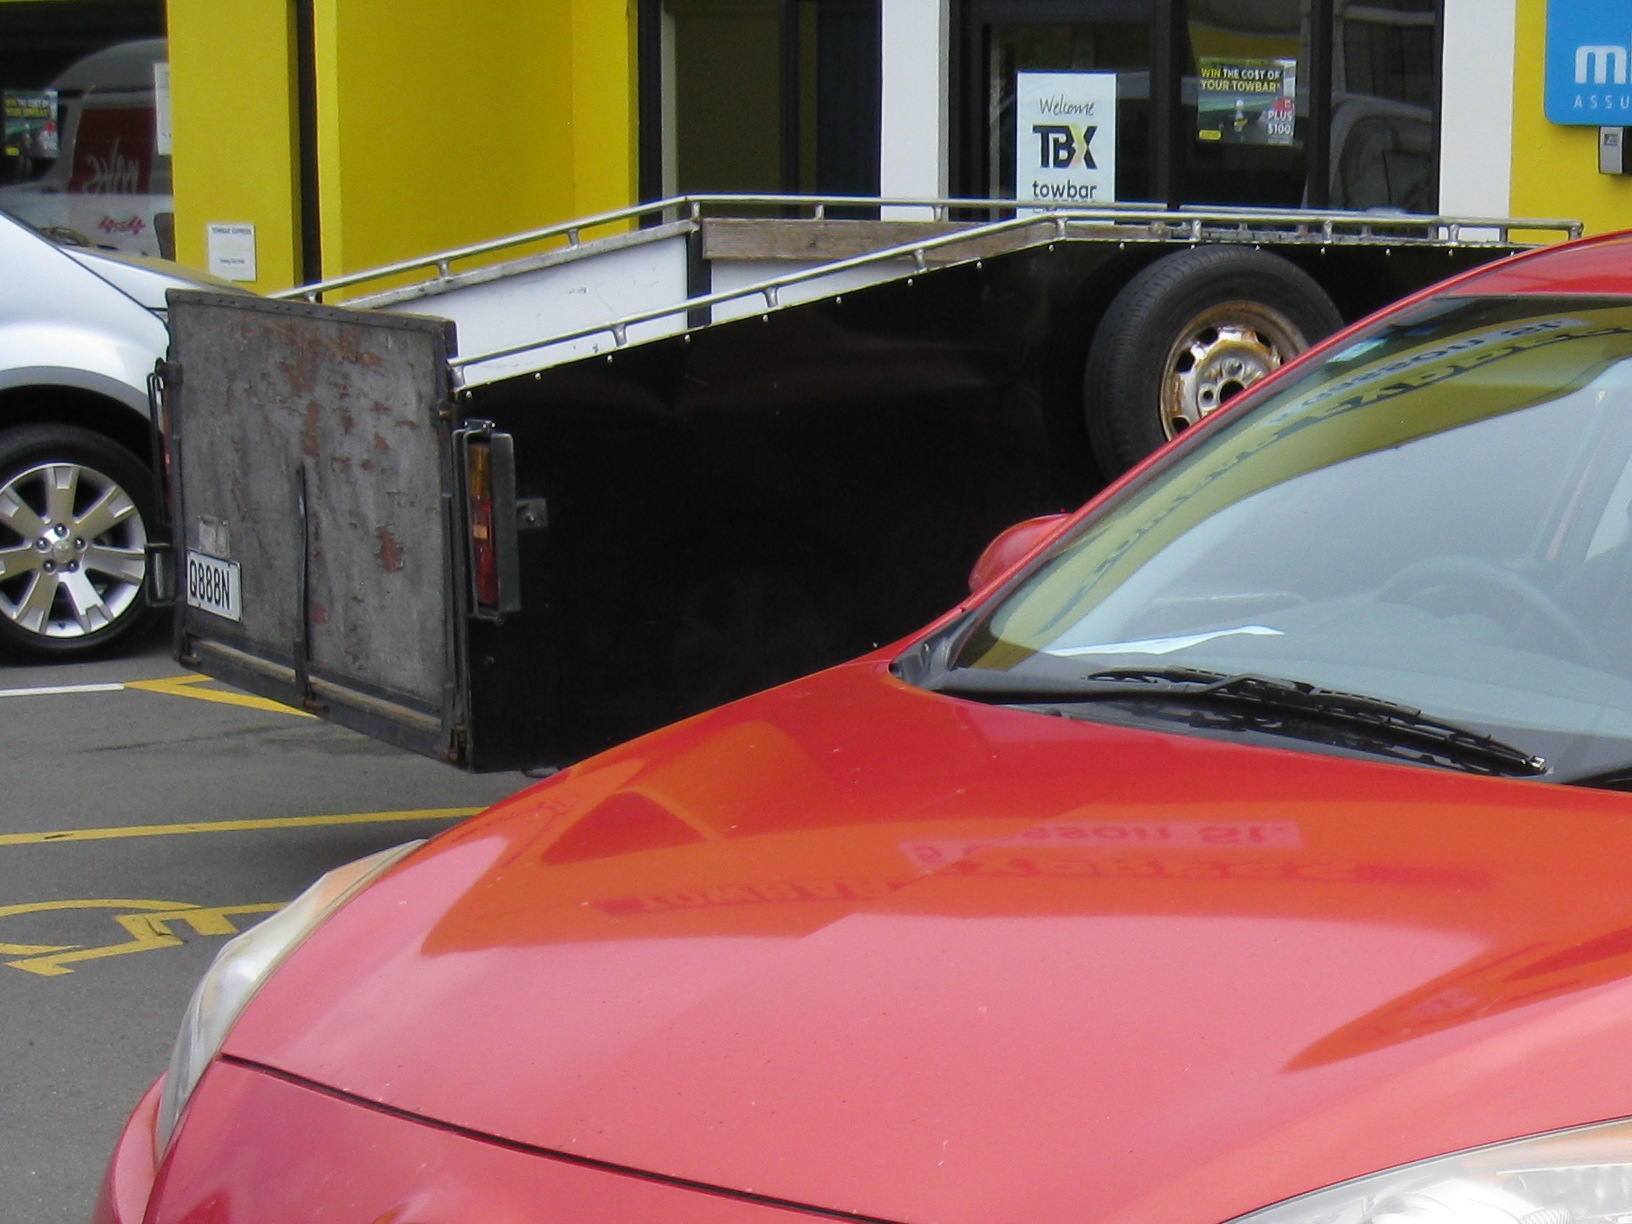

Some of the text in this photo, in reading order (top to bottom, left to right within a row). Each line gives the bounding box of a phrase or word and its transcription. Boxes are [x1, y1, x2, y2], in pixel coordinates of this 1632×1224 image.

[1201, 68, 1221, 78] WIN
[1223, 68, 1240, 79] THE
[1267, 70, 1280, 80] OF
[1201, 79, 1230, 91] YOUR
[1040, 94, 1095, 116] Welcome
[1268, 110, 1293, 121] PLUS
[1032, 124, 1098, 170] TBX
[1032, 179, 1098, 200] towbar
[189, 559, 231, 611] Q888N
